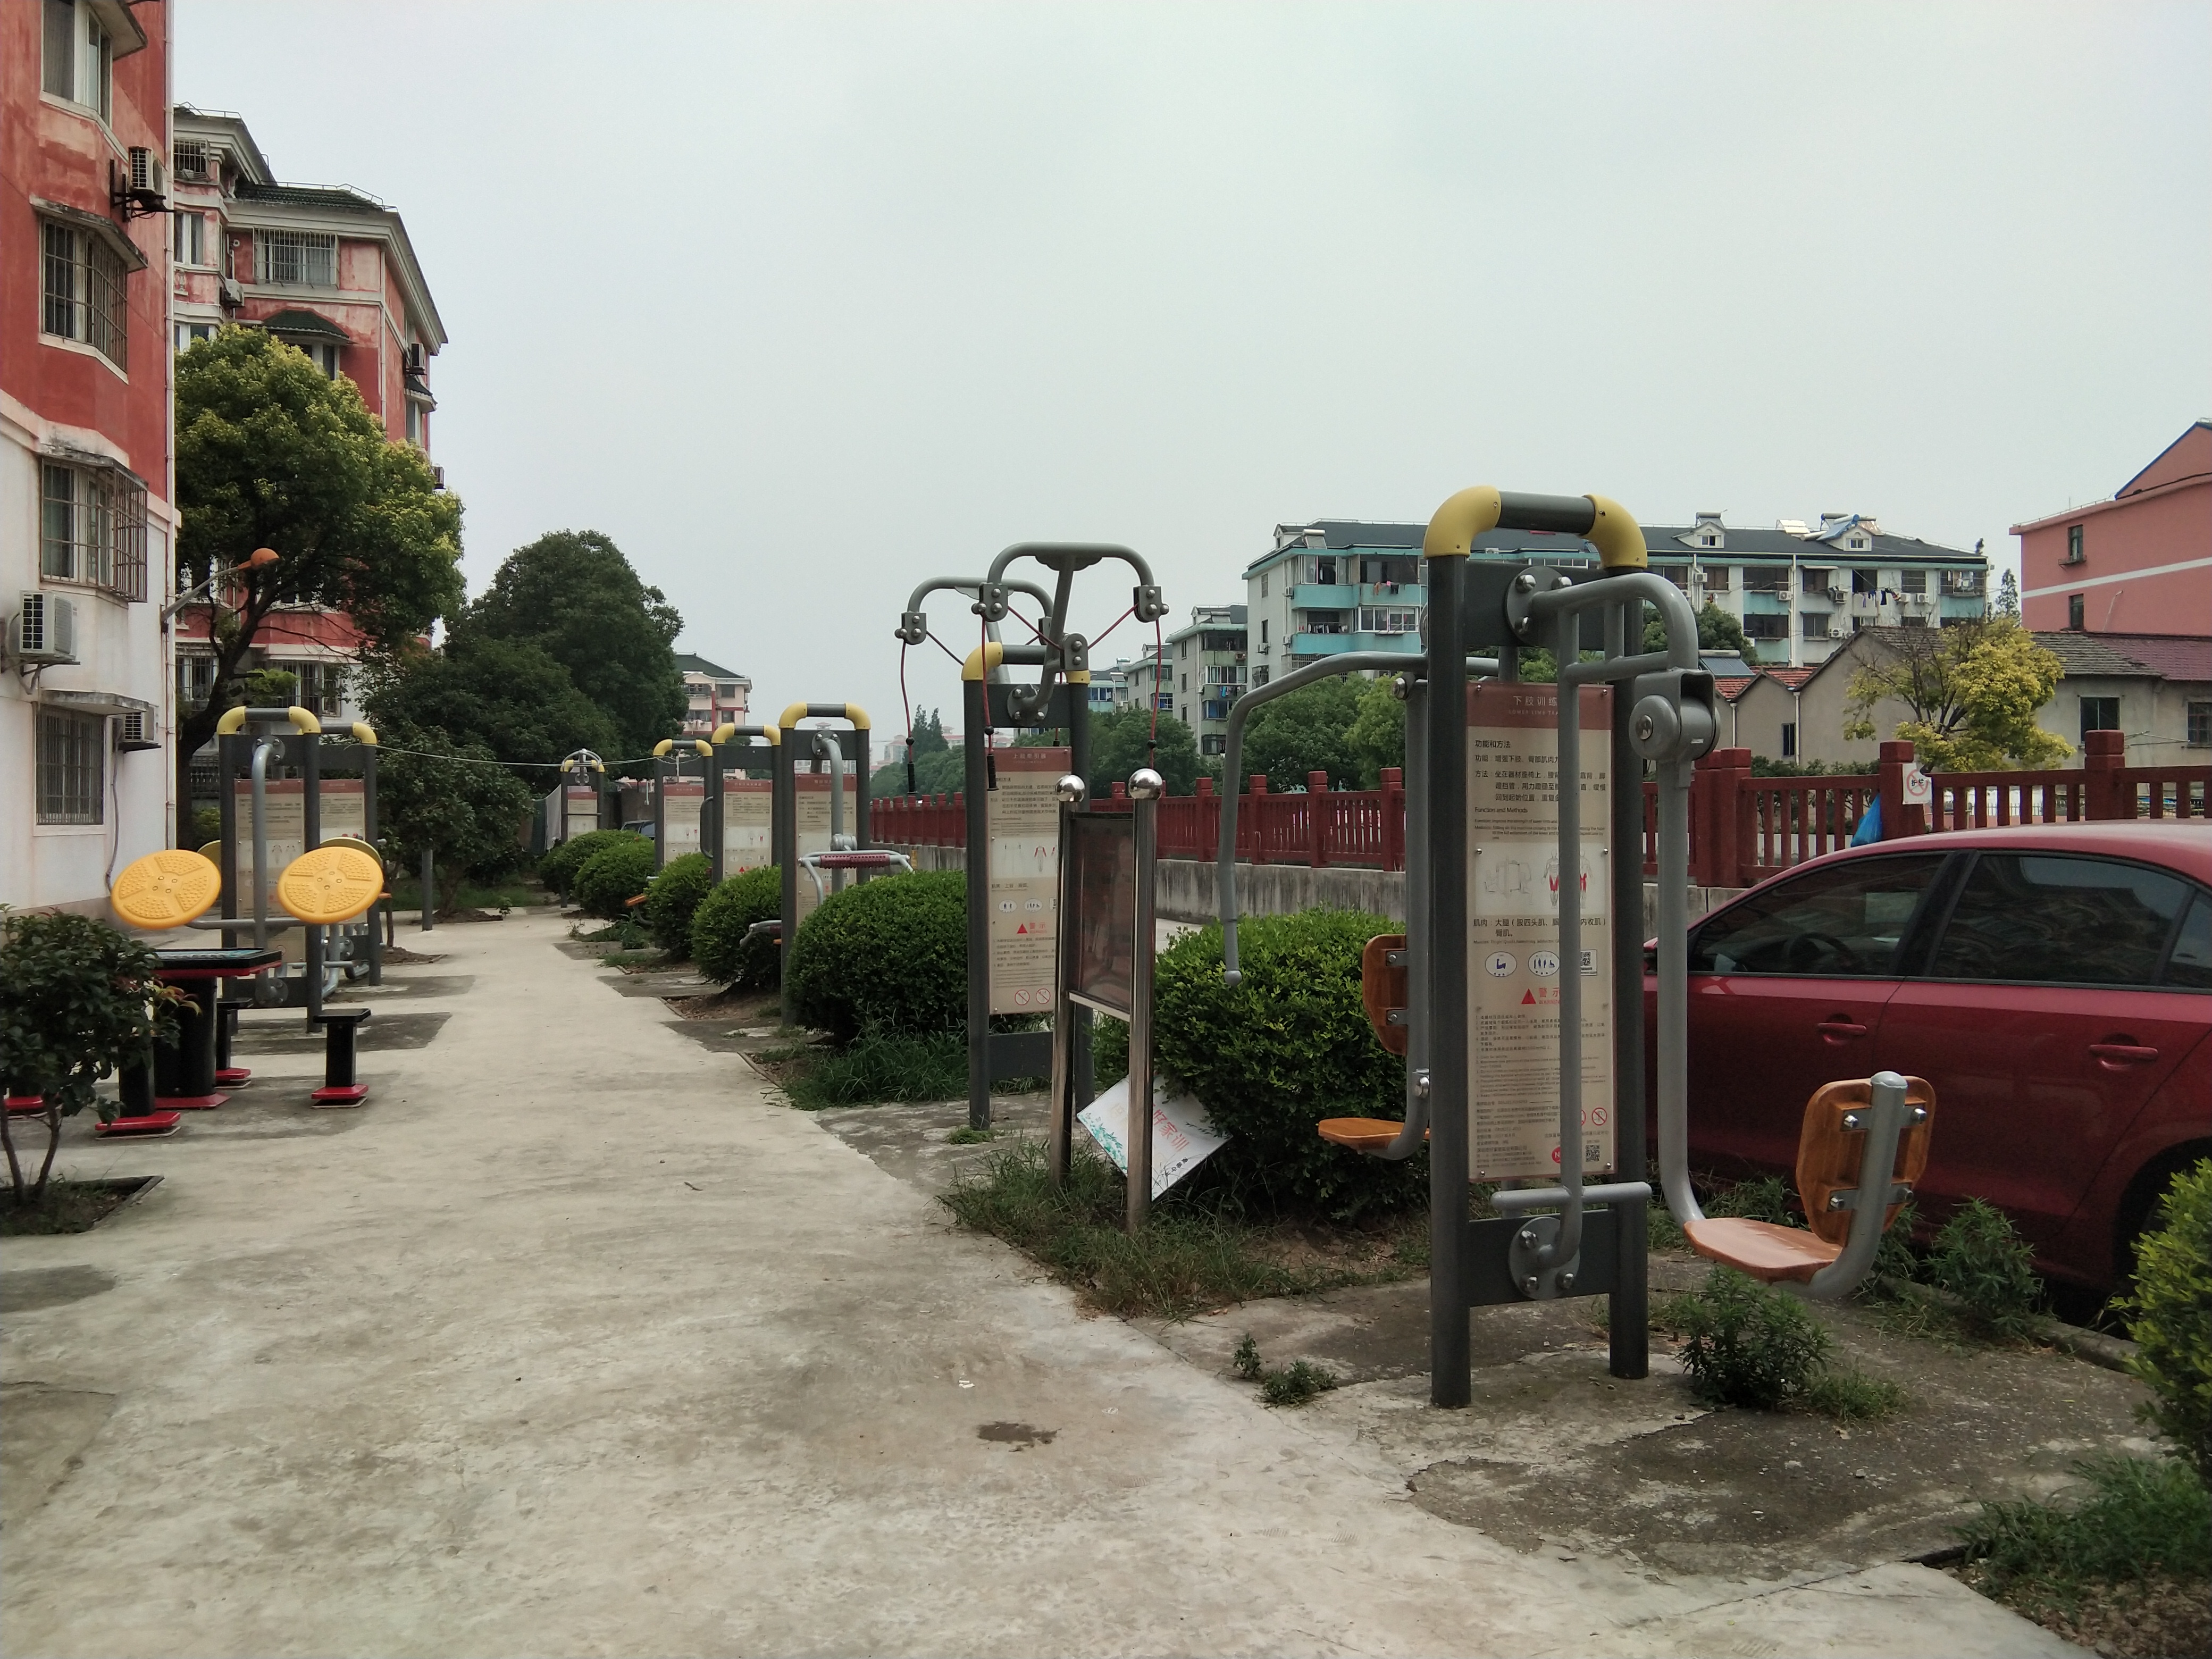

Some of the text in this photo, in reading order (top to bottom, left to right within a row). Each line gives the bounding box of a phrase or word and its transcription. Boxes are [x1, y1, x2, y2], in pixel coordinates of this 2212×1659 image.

[1513, 696, 1557, 707] 下肢训练
[1475, 740, 1511, 749] 功能和方法
[1153, 1109, 1189, 1152] 好家训
